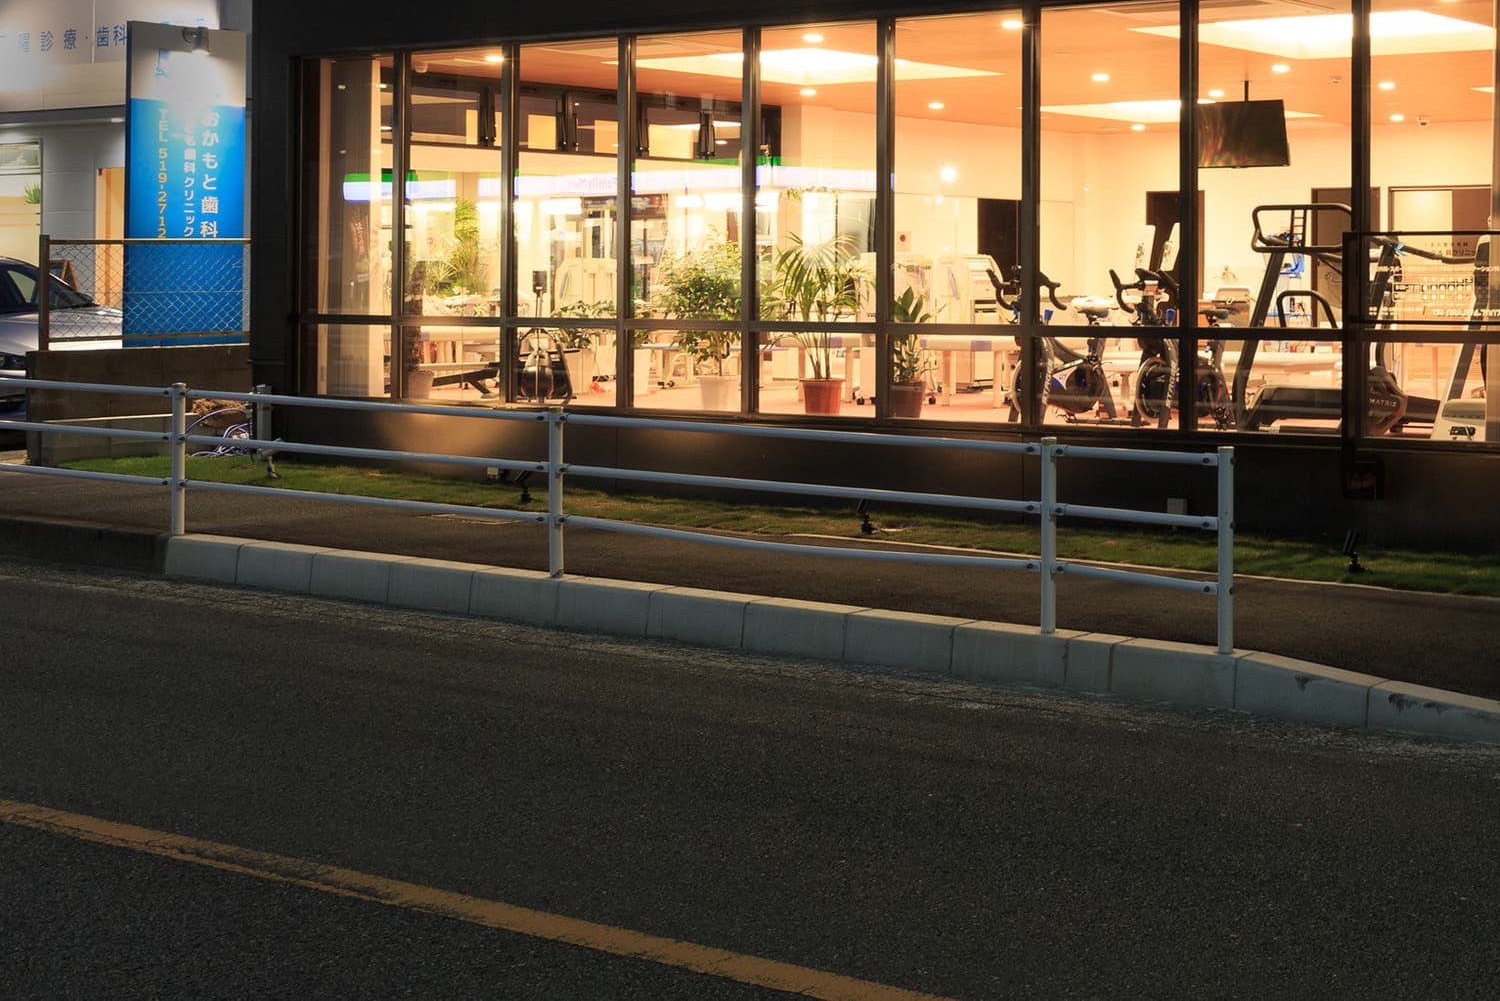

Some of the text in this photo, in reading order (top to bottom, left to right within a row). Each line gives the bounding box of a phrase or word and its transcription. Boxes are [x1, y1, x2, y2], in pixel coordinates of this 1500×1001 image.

[156, 108, 168, 239] TEL 519-2712
[200, 111, 219, 238] おかもと歯科
[1369, 398, 1398, 408] MATRIX
